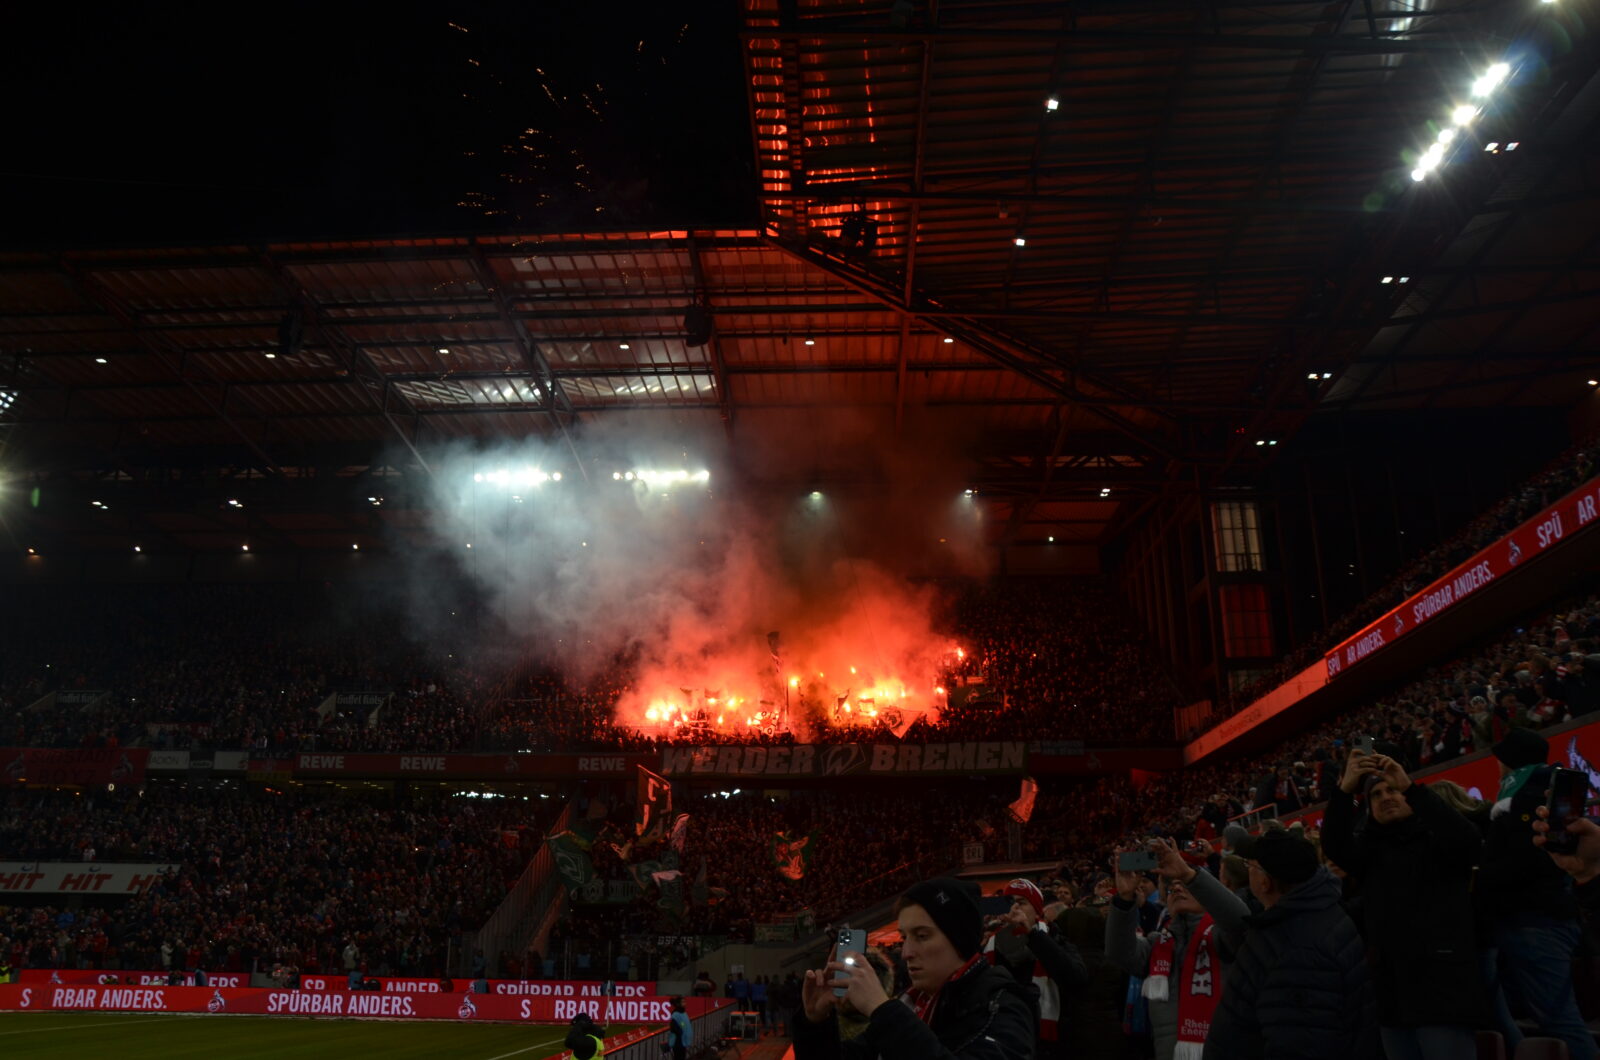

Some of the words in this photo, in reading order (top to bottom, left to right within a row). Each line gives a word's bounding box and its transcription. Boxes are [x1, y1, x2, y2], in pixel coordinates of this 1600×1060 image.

[1413, 584, 1454, 624] SPÜRBAR
[299, 755, 345, 769] REWE
[399, 756, 447, 770] REWE
[578, 757, 626, 771] REWE
[662, 744, 816, 774] WERDER
[869, 741, 1025, 771] BREMEN
[0, 873, 45, 889] HIT
[58, 874, 113, 890] HIT
[99, 989, 168, 1010] ANDERS.
[581, 985, 647, 997] ANERS
[267, 990, 343, 1014] SPÜRBAR
[347, 994, 417, 1016] ANDERS.
